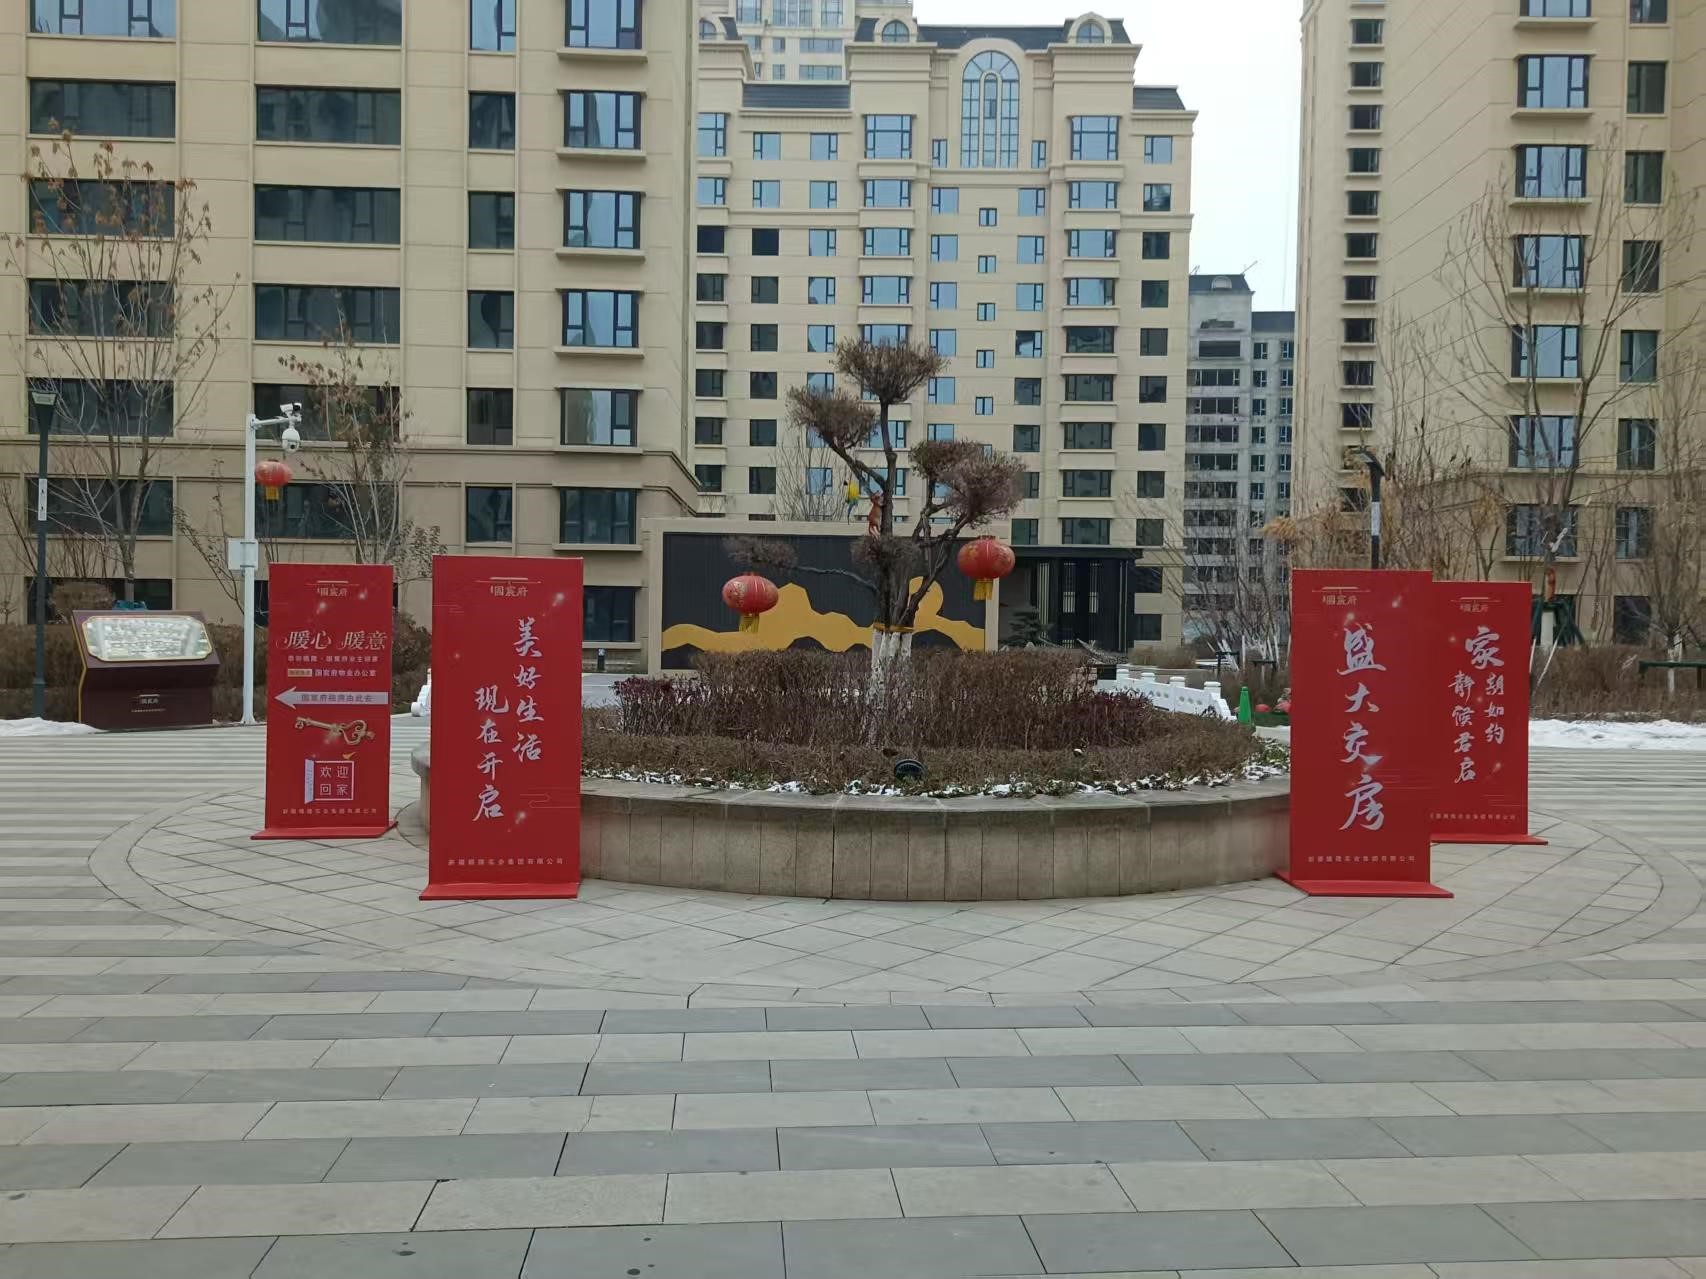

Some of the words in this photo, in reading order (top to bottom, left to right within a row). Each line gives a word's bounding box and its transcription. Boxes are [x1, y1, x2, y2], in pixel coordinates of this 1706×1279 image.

[283, 630, 332, 650] 暖心
[338, 630, 388, 650] 暖意
[512, 616, 544, 763] 美好生活
[319, 765, 349, 778] 欢迎
[472, 684, 509, 822] 现在开启
[1336, 623, 1387, 831] 盛大交房
[1448, 670, 1477, 784] 静候君启
[319, 784, 349, 796] 回家
